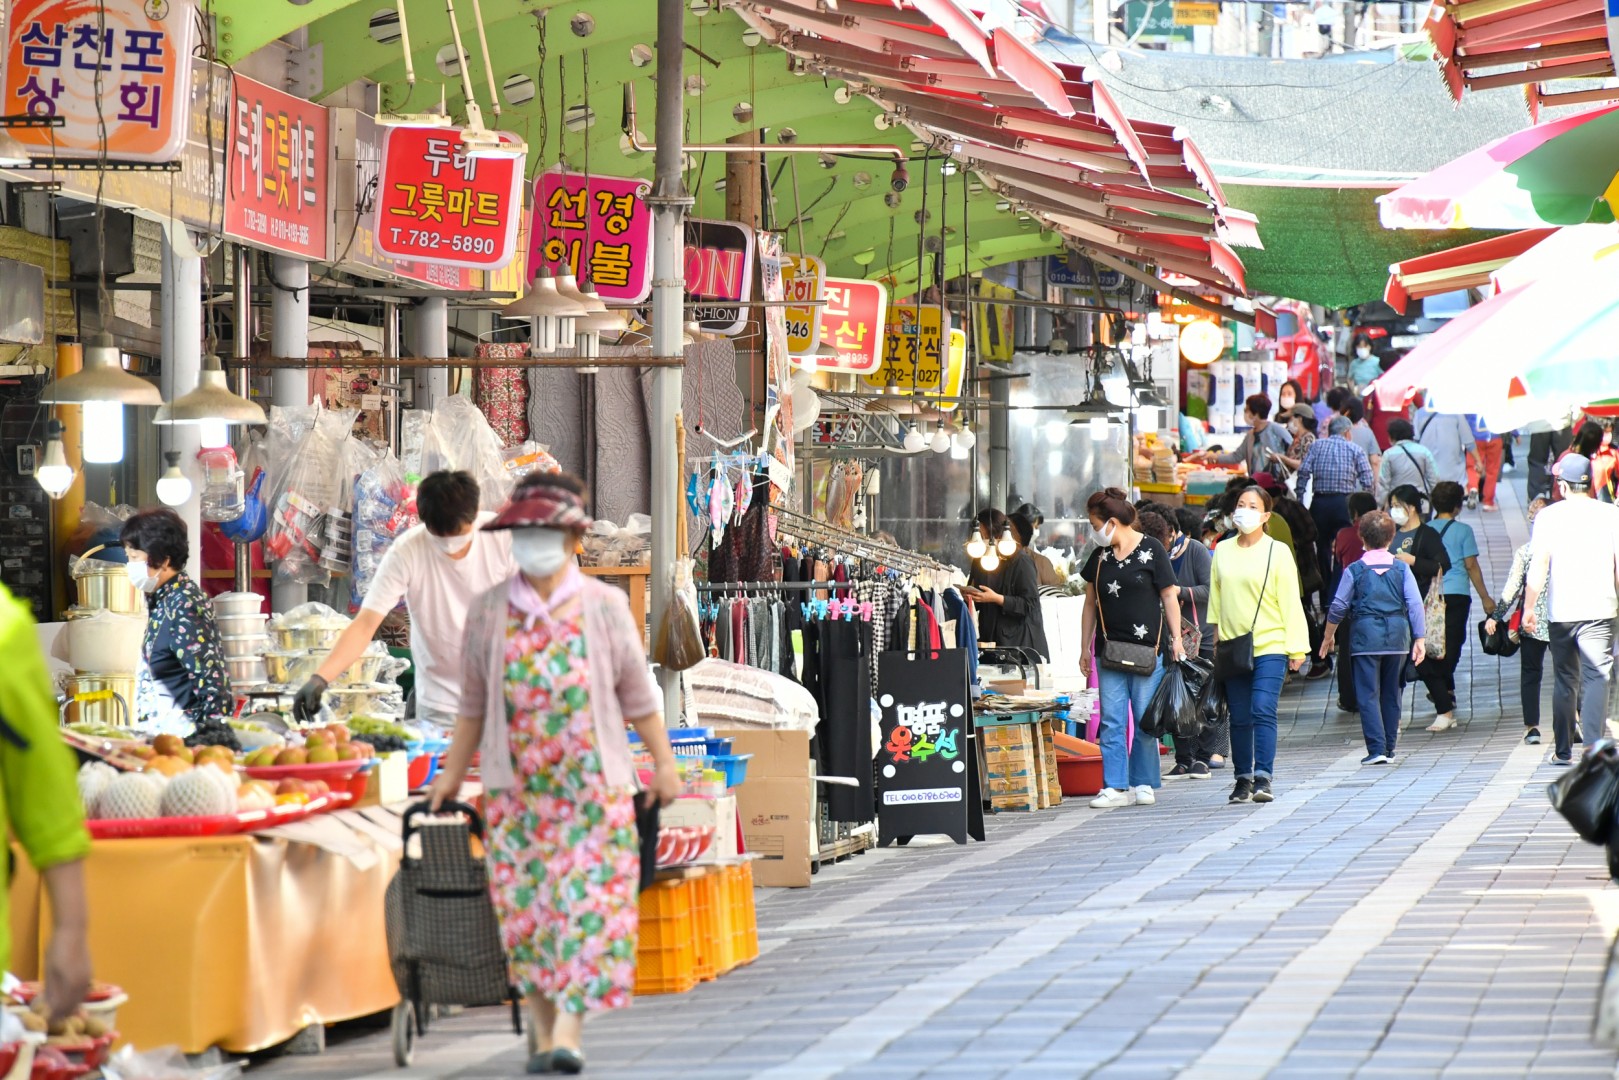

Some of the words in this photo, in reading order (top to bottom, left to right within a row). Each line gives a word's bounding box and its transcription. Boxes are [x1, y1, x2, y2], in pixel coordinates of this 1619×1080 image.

[19, 22, 165, 74] 삼천포
[423, 137, 478, 182] 두레
[390, 182, 500, 228] 그릇마트
[546, 186, 635, 235] 선경
[390, 227, 495, 256] T.782-5890
[545, 239, 632, 287] 이불
[819, 320, 868, 350] 산
[896, 701, 948, 736] 명품
[885, 725, 961, 763] 옷수선
